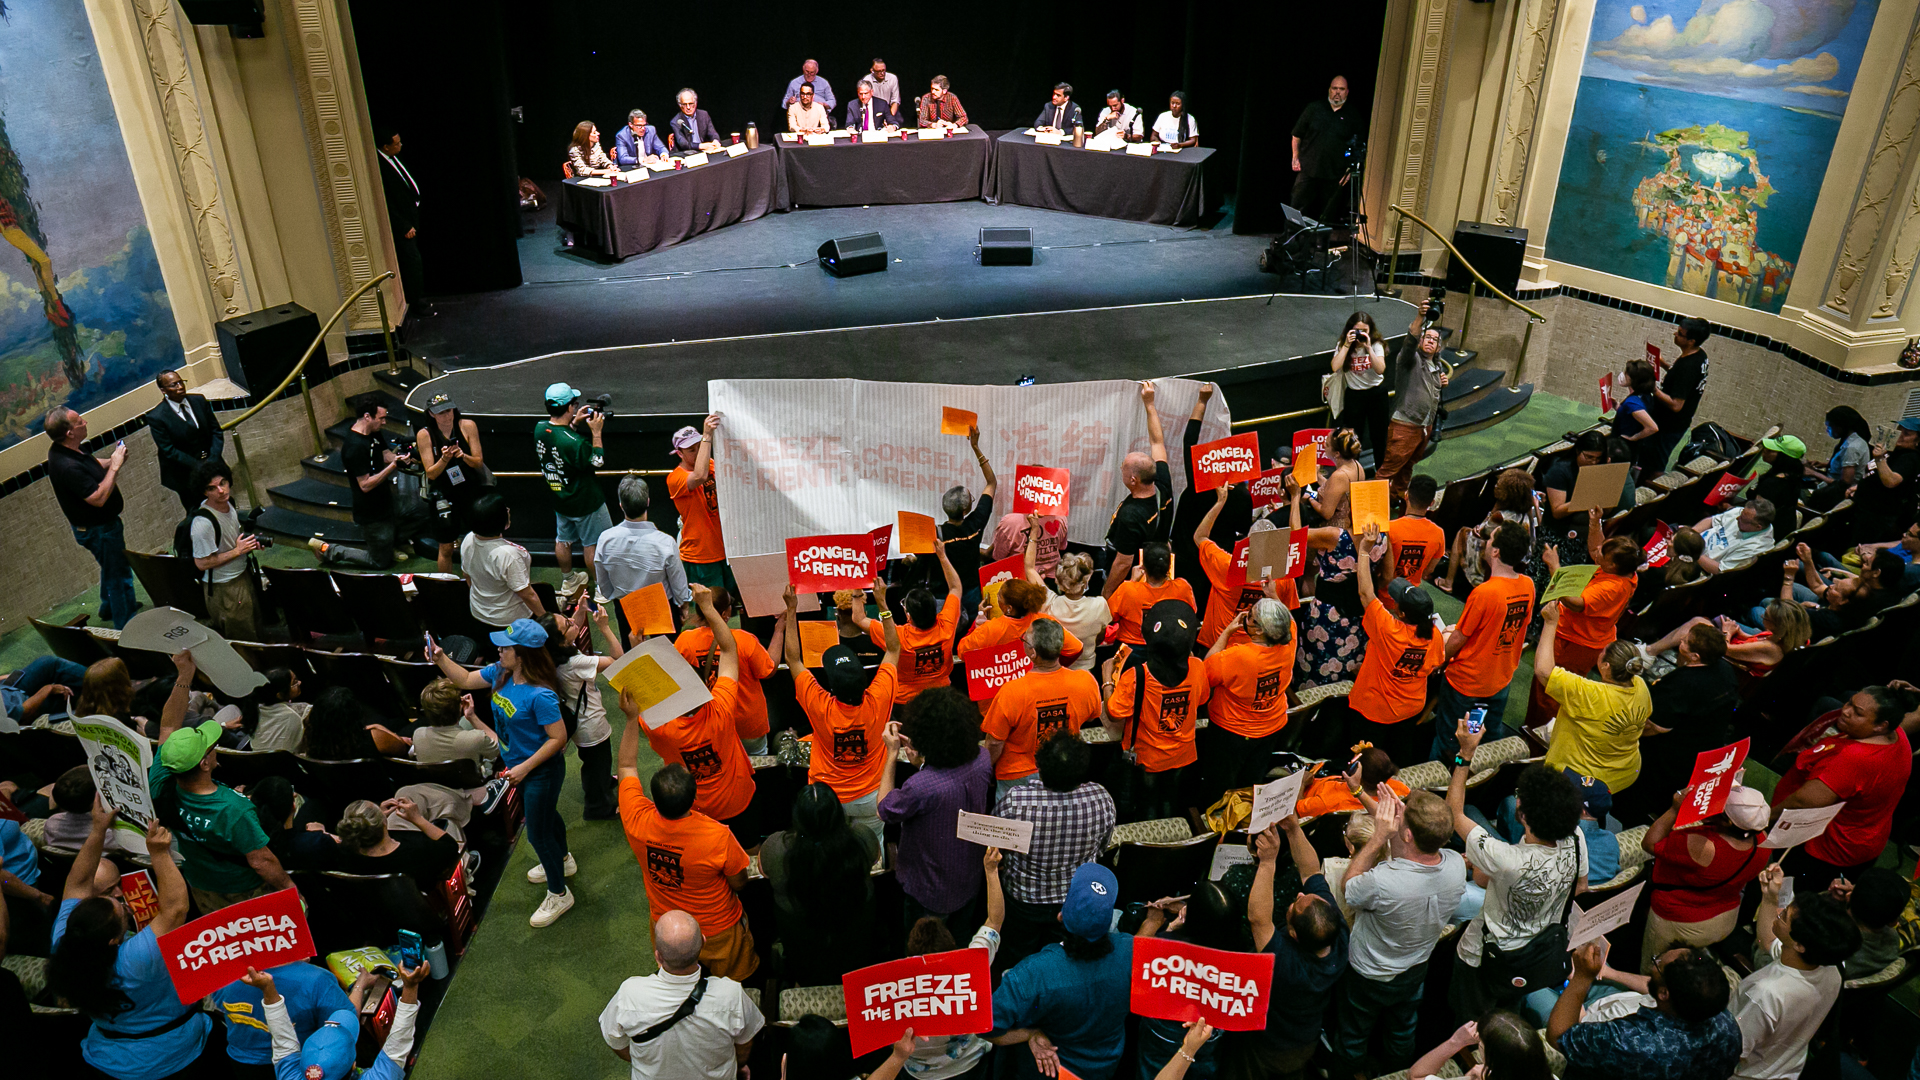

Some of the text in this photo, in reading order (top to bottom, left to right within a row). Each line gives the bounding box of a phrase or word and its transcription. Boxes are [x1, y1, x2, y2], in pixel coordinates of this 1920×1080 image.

[723, 436, 843, 463] FREEZE
[1198, 447, 1255, 471] ¡CONGELA
[723, 458, 848, 492] THE RENT!
[1203, 459, 1253, 474] LA RENTA!
[1018, 474, 1064, 495] ¡CONGELA
[1251, 475, 1281, 495] ¡CONG
[1024, 488, 1062, 507] RENTA!
[793, 546, 870, 569] ¡CONGELA
[800, 561, 868, 579] LA RENTA!
[1508, 606, 1525, 615] CASA
[163, 625, 190, 640] RGB
[994, 649, 1018, 664] LOS
[970, 655, 1031, 680] INQUILINO
[1259, 678, 1278, 688] CASA
[1164, 696, 1186, 704] CASA
[1040, 709, 1064, 718] CASA
[837, 734, 862, 743] CASA
[685, 750, 712, 761] CASA
[115, 784, 142, 805] RGB
[649, 852, 677, 866] CASA
[177, 915, 297, 970] ¡CONGELA
[191, 929, 298, 971] LA RENTA!
[1142, 955, 1259, 997] ¡CONGELA
[864, 973, 972, 1007] FREEZE
[1151, 976, 1254, 1017] LA RENTA!
[861, 991, 978, 1022] THE RENT!
